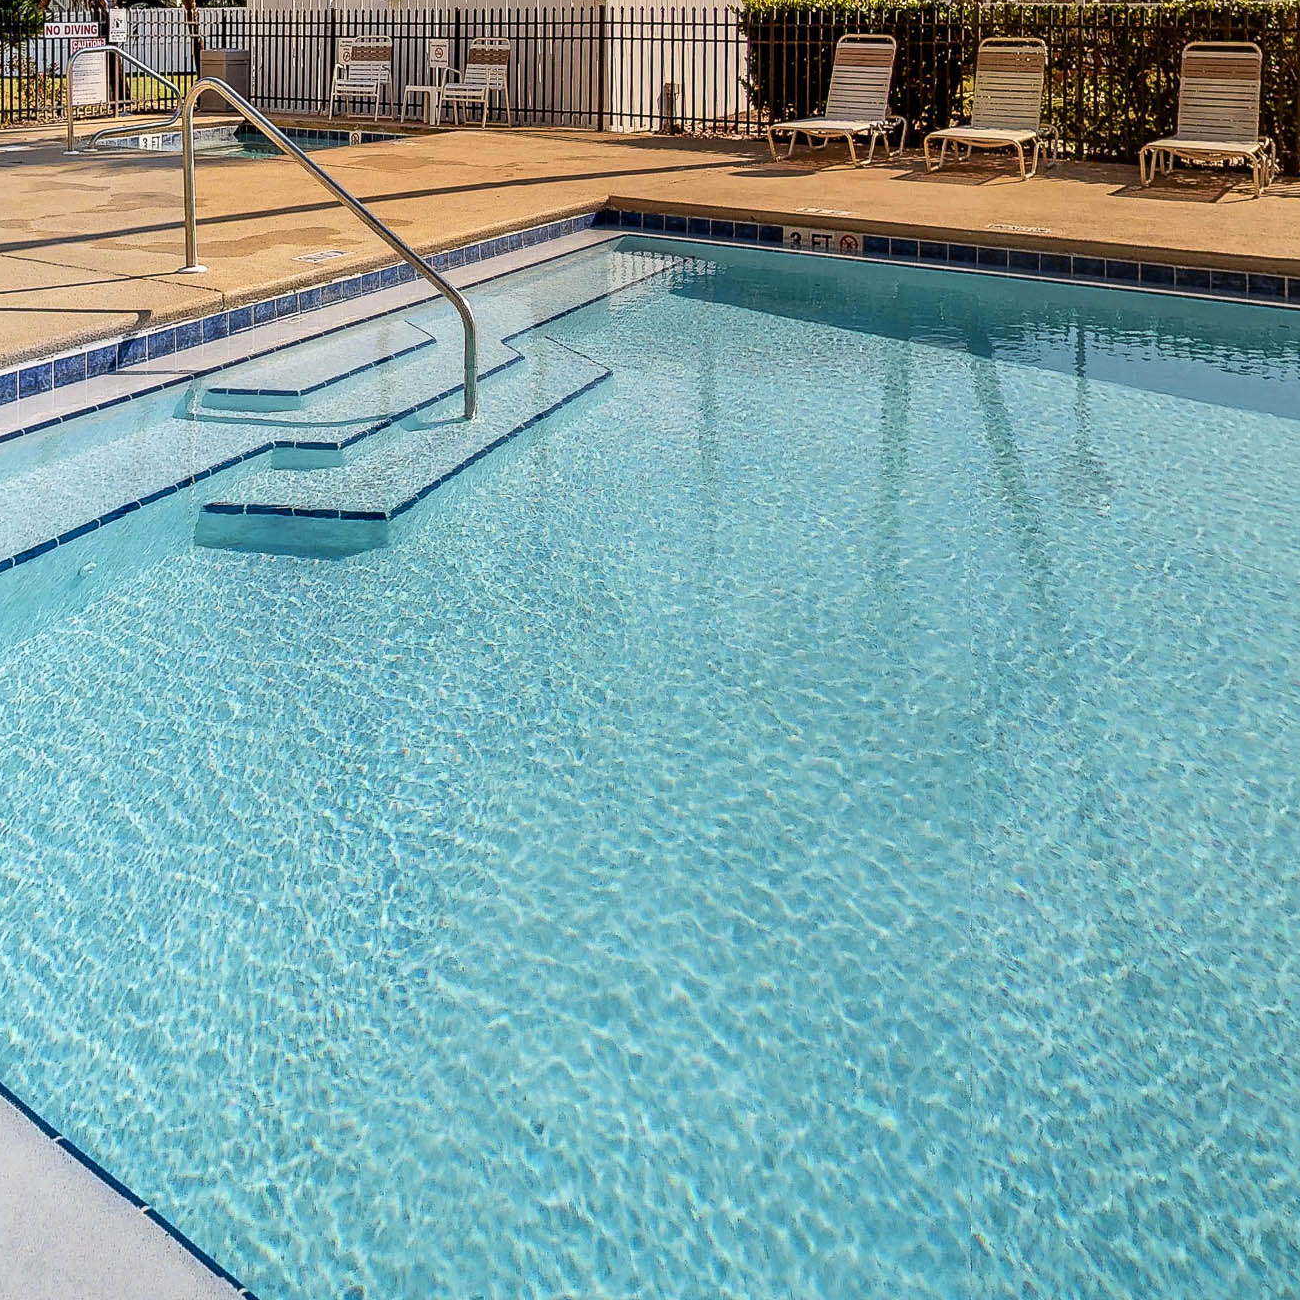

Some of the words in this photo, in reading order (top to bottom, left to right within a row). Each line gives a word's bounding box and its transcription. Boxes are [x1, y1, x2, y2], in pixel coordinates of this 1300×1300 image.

[46, 25, 61, 35] NO
[64, 24, 97, 35] DIVING
[811, 233, 833, 247] FT
